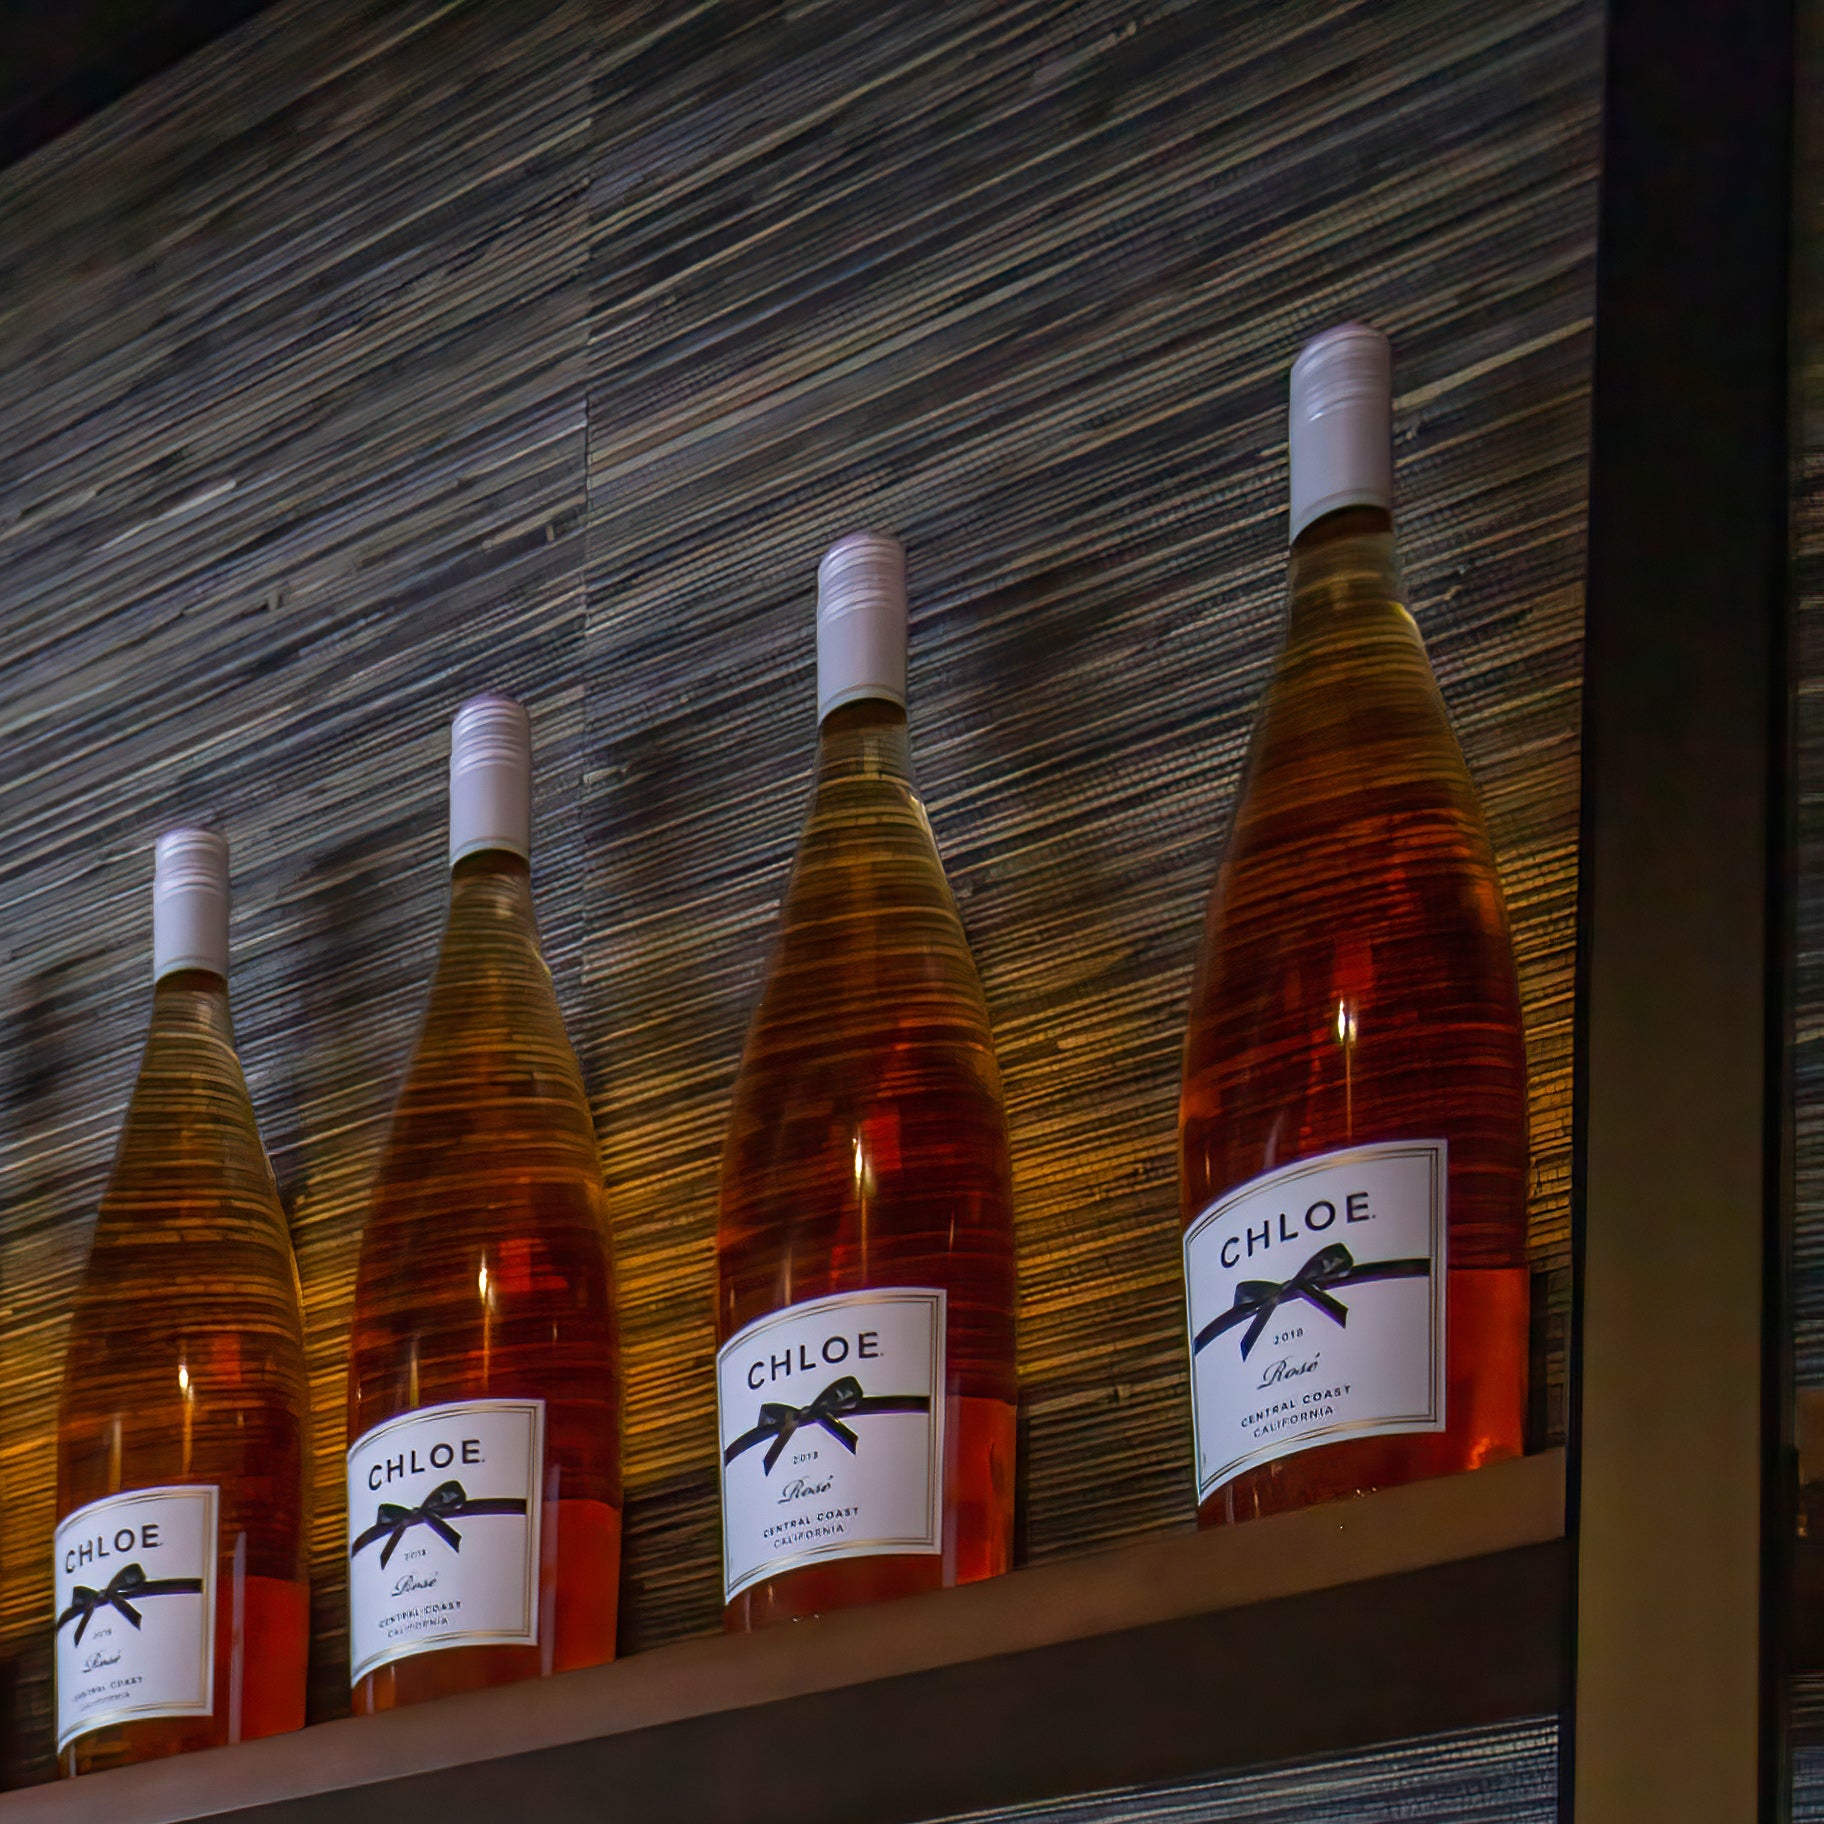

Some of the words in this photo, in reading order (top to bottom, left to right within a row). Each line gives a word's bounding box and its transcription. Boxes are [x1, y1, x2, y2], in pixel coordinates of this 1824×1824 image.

[1220, 1191, 1370, 1269] CHLOE
[1273, 1328, 1304, 1345] 2018
[747, 1331, 879, 1390] CHLOE
[1257, 1352, 1321, 1390] Rosé
[1241, 1399, 1296, 1428] CENTRAL
[1302, 1385, 1352, 1405] COAST
[1253, 1405, 1334, 1438] CALIFORNIA
[368, 1439, 481, 1491] CHLOE
[763, 1517, 810, 1538] CENTRAL
[817, 1507, 860, 1521] COAST
[774, 1524, 844, 1548] CALIFORNIA
[66, 1524, 159, 1574] CHLOE
